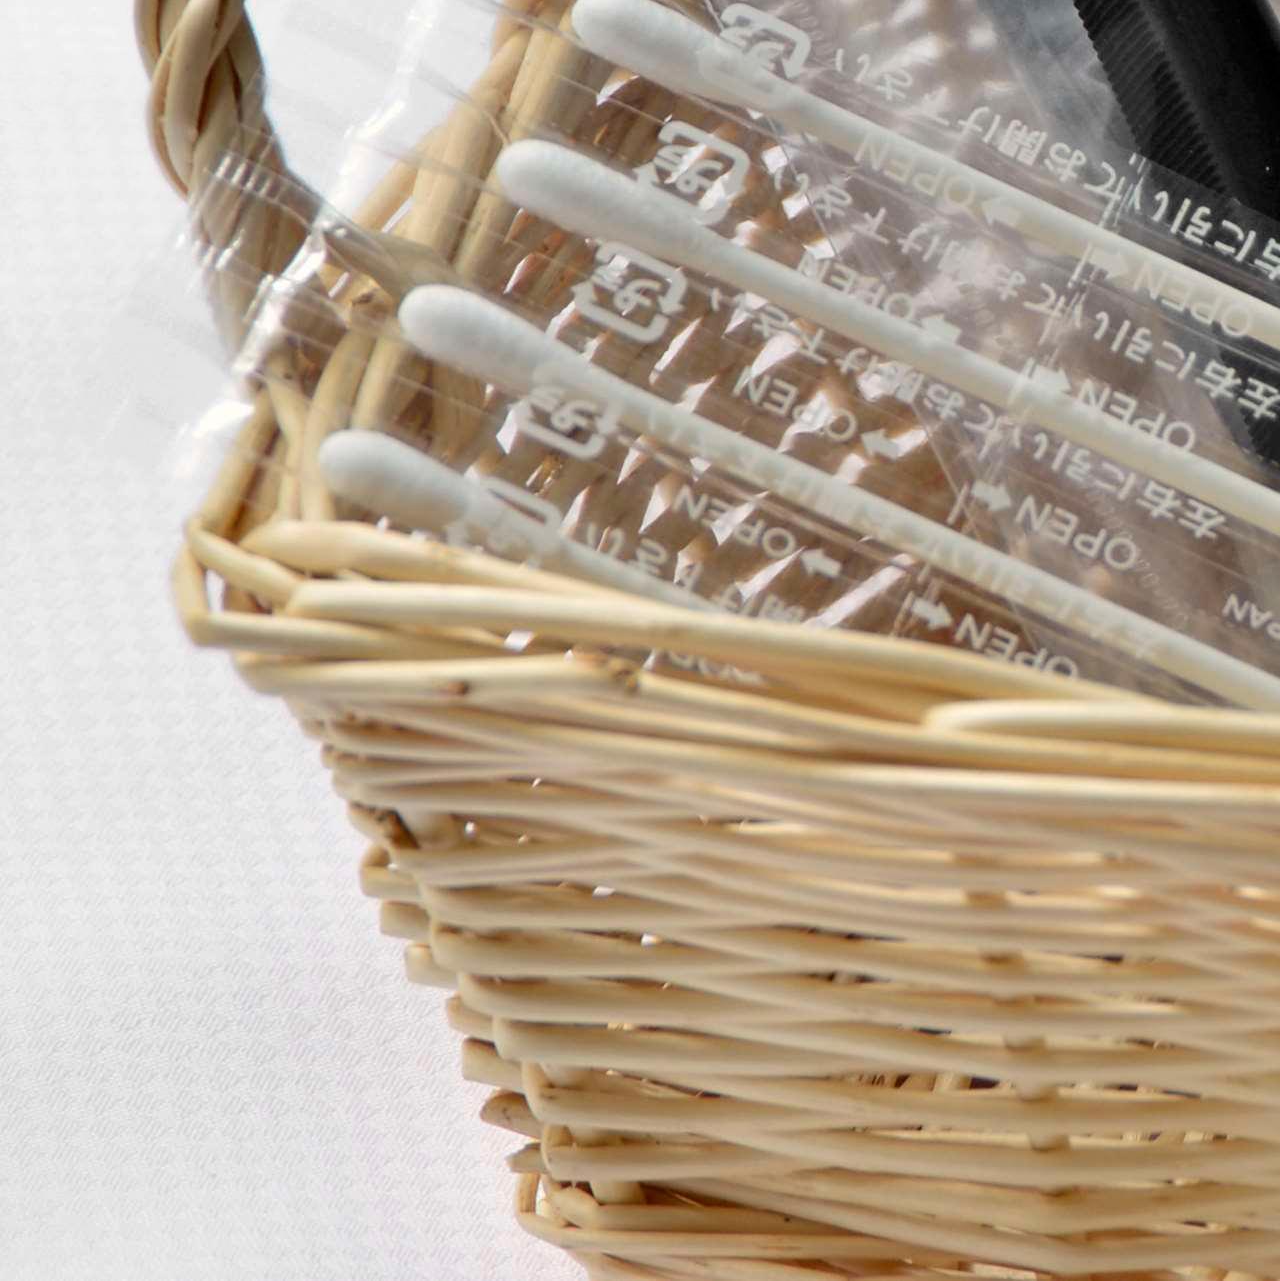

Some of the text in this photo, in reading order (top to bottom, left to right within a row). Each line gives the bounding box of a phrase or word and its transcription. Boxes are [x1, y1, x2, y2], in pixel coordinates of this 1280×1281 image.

[852, 131, 1257, 338] OPEN OPEN
[731, 363, 1141, 571] OPEN OPEN
[1075, 377, 1199, 453] OPEN
[667, 480, 1082, 692] OPEN OPEN
